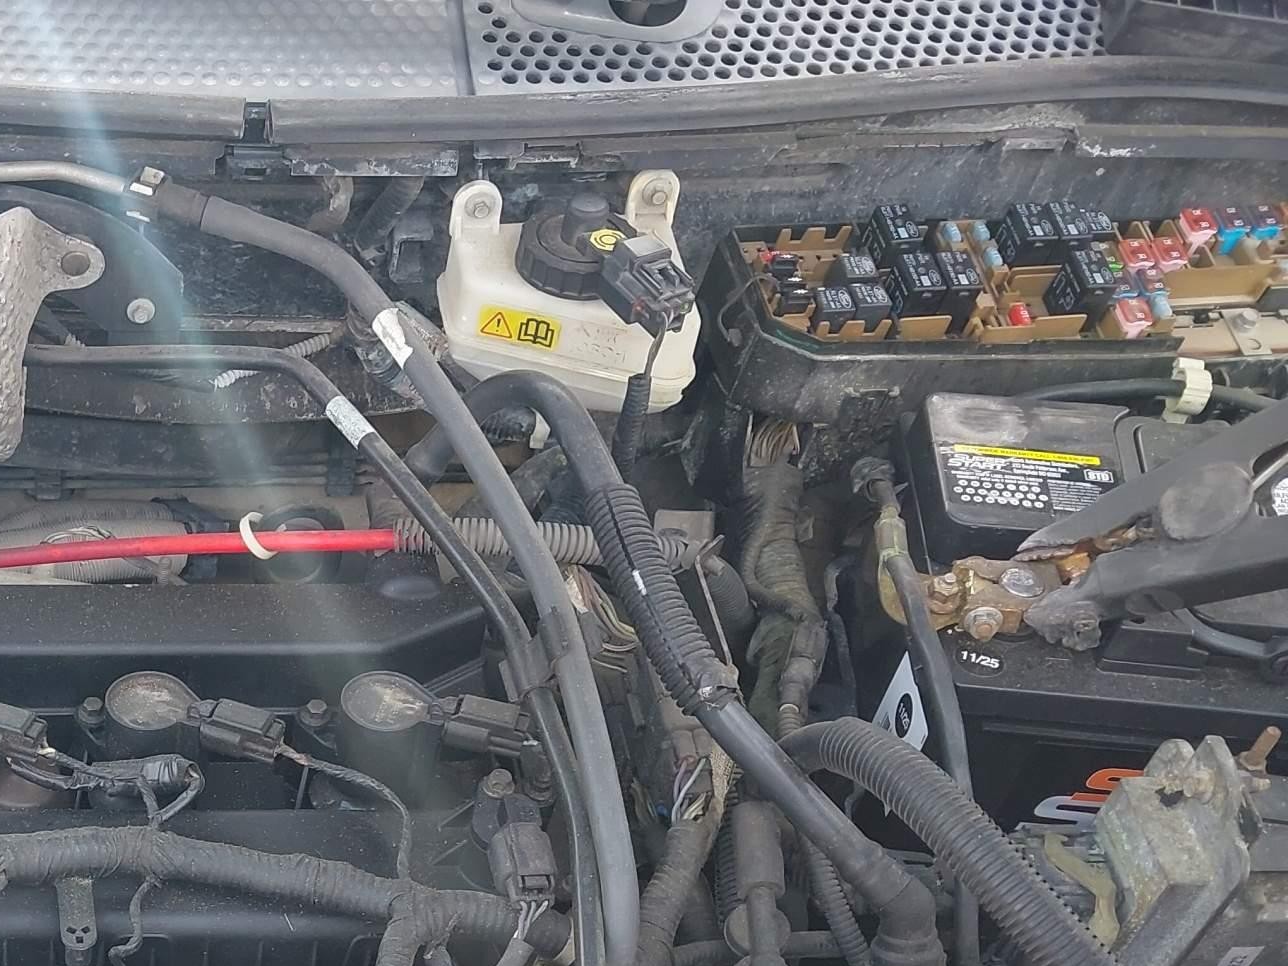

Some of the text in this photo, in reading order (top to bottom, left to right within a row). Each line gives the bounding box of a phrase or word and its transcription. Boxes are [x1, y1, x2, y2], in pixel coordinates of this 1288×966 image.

[947, 458, 1007, 471] START
[953, 453, 1008, 466] SUPER
[961, 650, 1000, 669] 11/25
